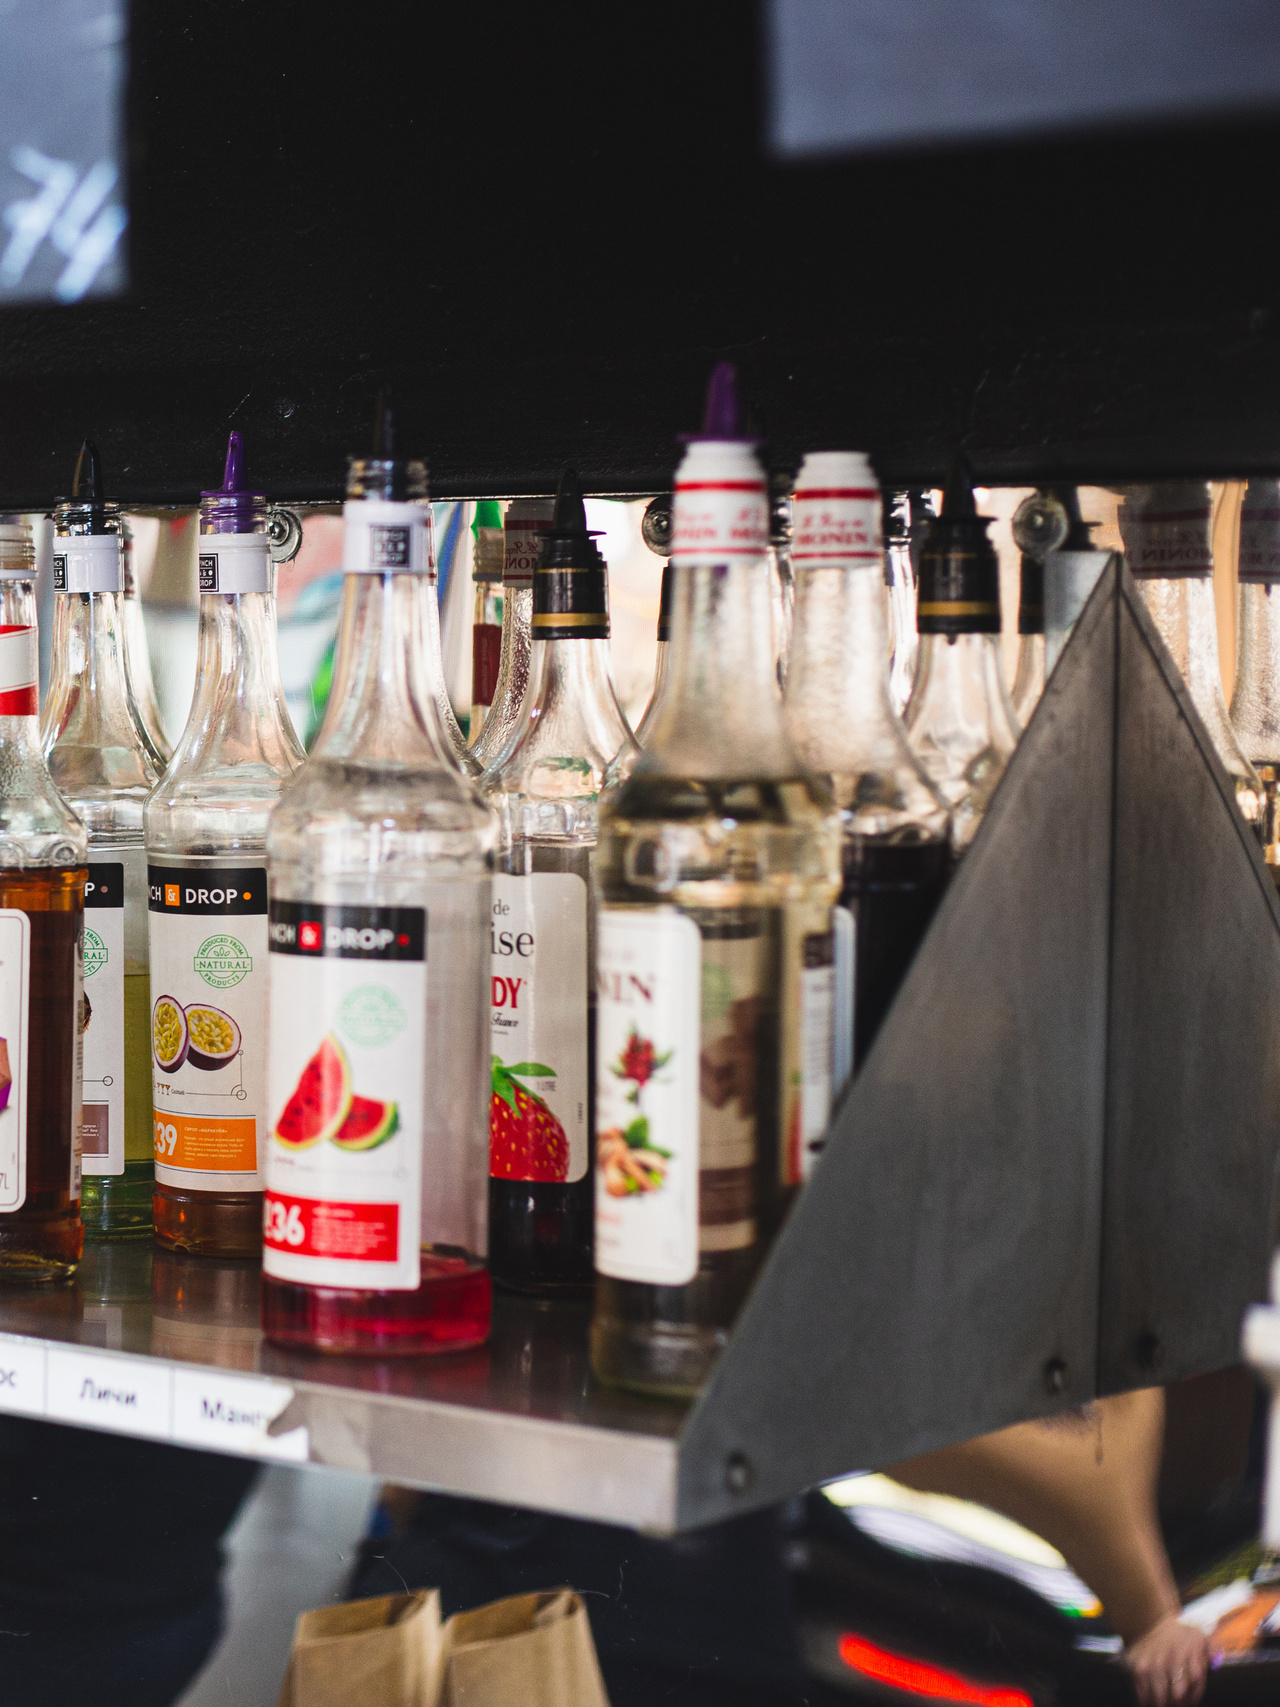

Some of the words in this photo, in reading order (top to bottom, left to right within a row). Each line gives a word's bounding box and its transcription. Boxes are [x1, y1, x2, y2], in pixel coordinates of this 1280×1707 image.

[185, 888, 239, 904] DROP
[492, 898, 511, 916] de
[200, 937, 229, 956] PRODUCED
[229, 938, 245, 956] FROM
[325, 926, 395, 951] DROP
[199, 960, 248, 969] NATURAL
[203, 972, 241, 986] PRODUCTS
[79, 1377, 138, 1408] Личи
